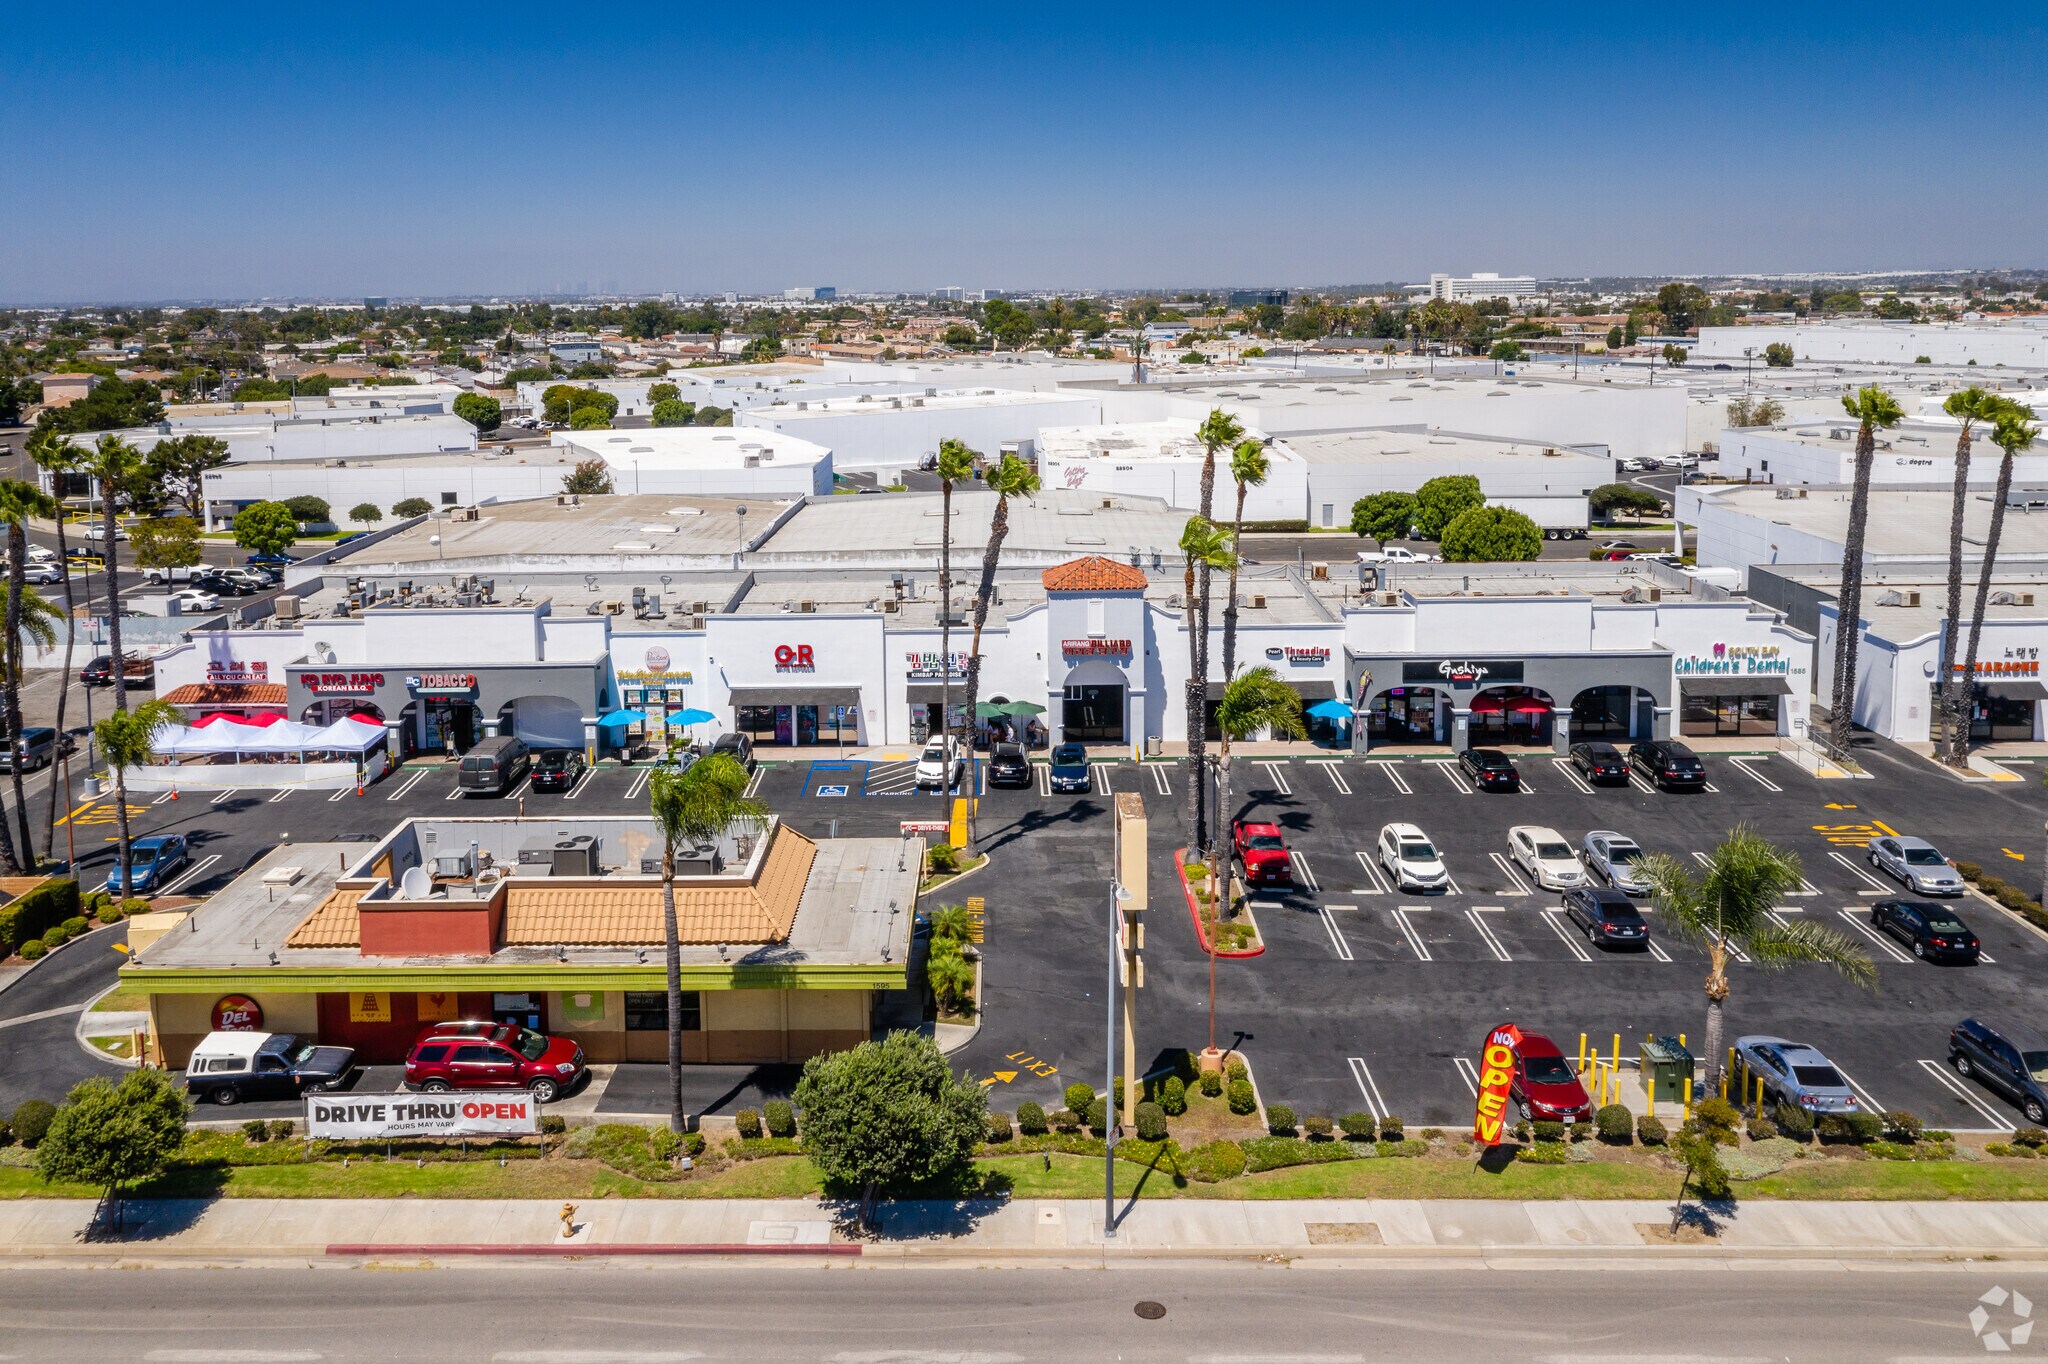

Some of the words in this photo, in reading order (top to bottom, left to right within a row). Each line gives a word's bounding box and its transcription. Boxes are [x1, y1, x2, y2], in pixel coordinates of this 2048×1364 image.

[1285, 646, 1330, 656] Threading
[2004, 646, 2039, 659] 노래방
[1675, 656, 1740, 672] Children's
[1747, 657, 1790, 673] Dental
[301, 673, 319, 684] KO
[321, 673, 347, 685] RYO
[350, 672, 384, 685] JUNG
[420, 673, 475, 688] TOBACCO
[222, 1011, 250, 1025] DEL
[1006, 1051, 1058, 1077] EXIT
[1474, 1045, 1514, 1142] OPEN
[315, 1104, 386, 1122] DRIVE
[393, 1103, 456, 1121] THRU
[462, 1103, 527, 1119] OPEN
[388, 1122, 416, 1131] HOURS
[417, 1121, 435, 1129] MAY
